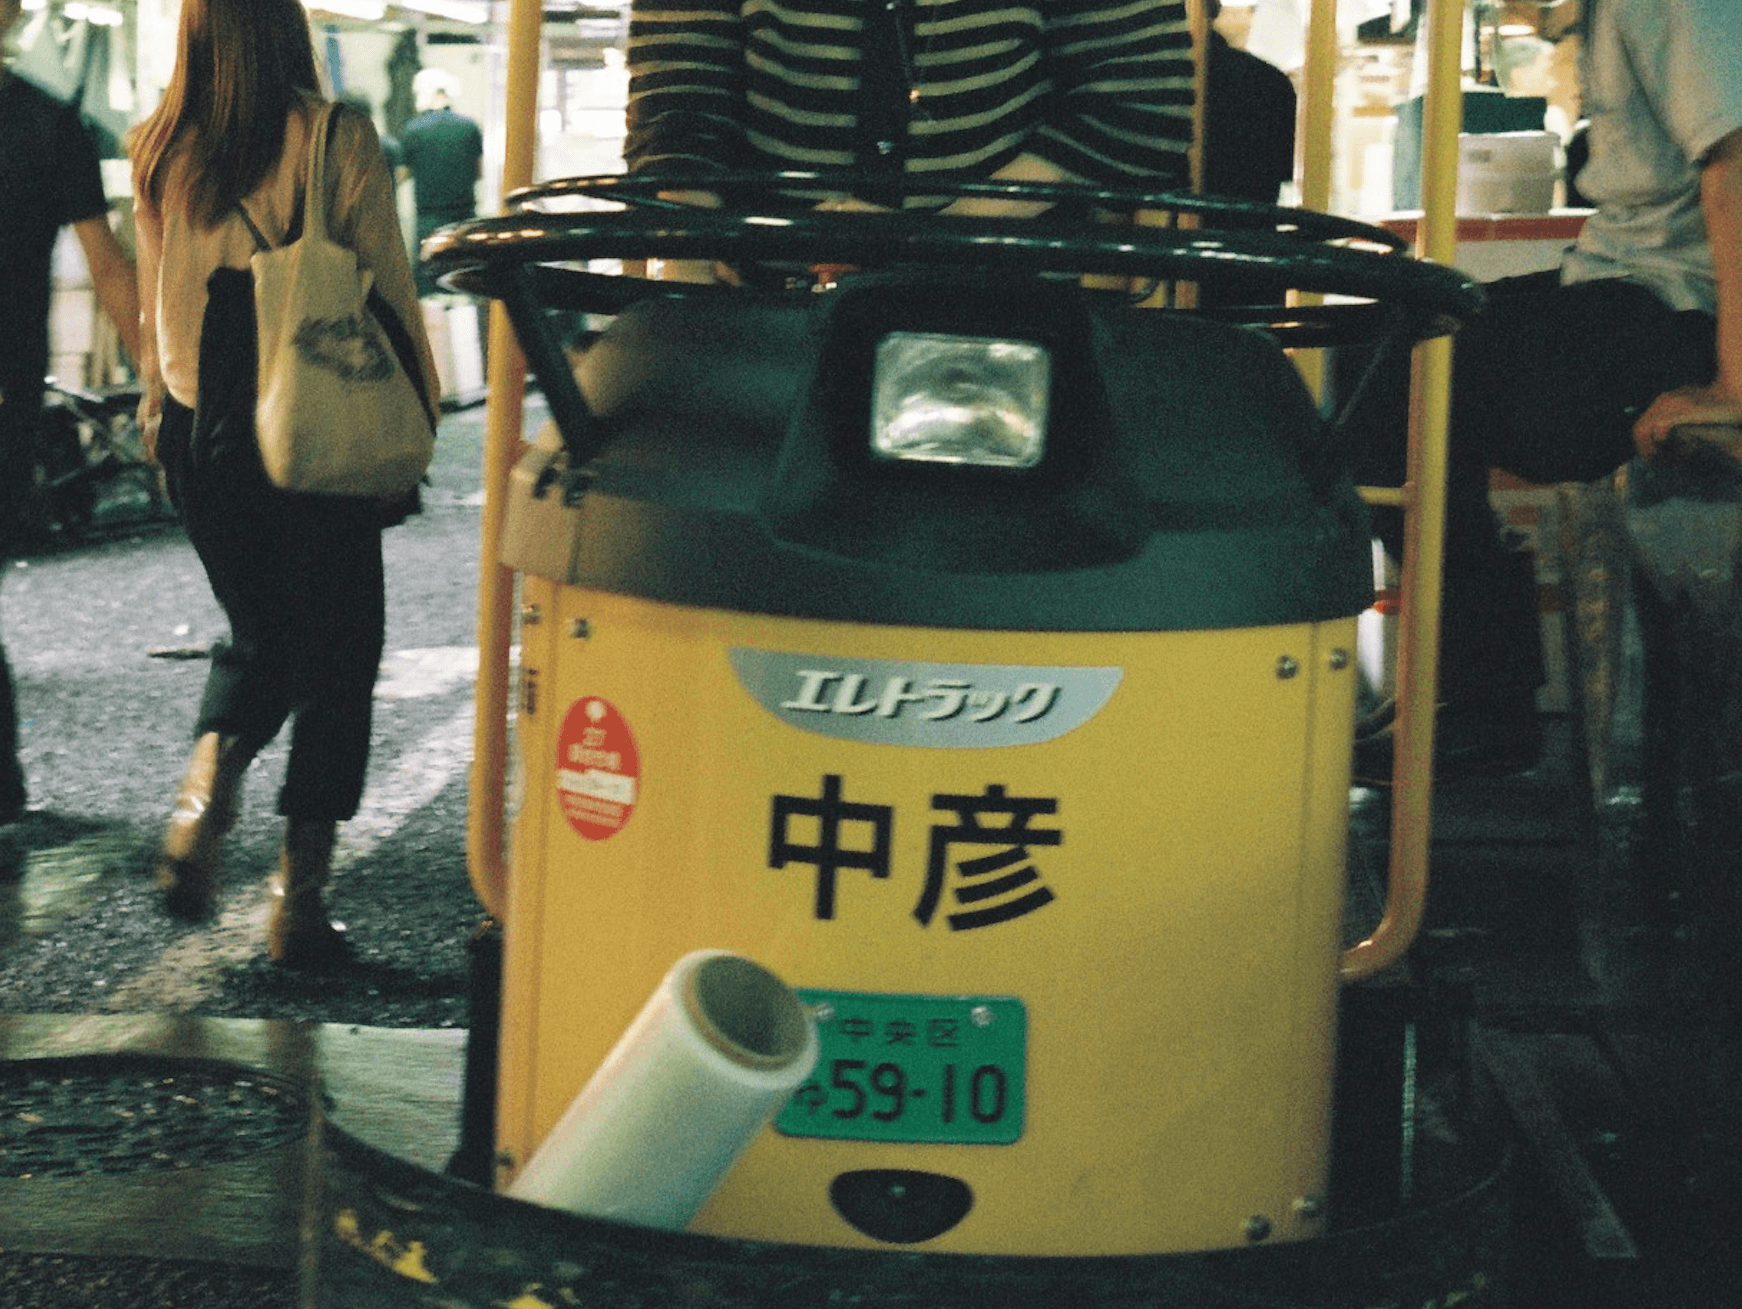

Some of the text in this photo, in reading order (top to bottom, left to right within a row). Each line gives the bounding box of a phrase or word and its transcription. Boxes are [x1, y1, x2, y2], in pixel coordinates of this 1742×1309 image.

[781, 670, 1061, 724] エレトラック
[768, 774, 1063, 931] 中彦
[839, 1017, 960, 1047] 中央区
[831, 1058, 1008, 1124] 59-10
